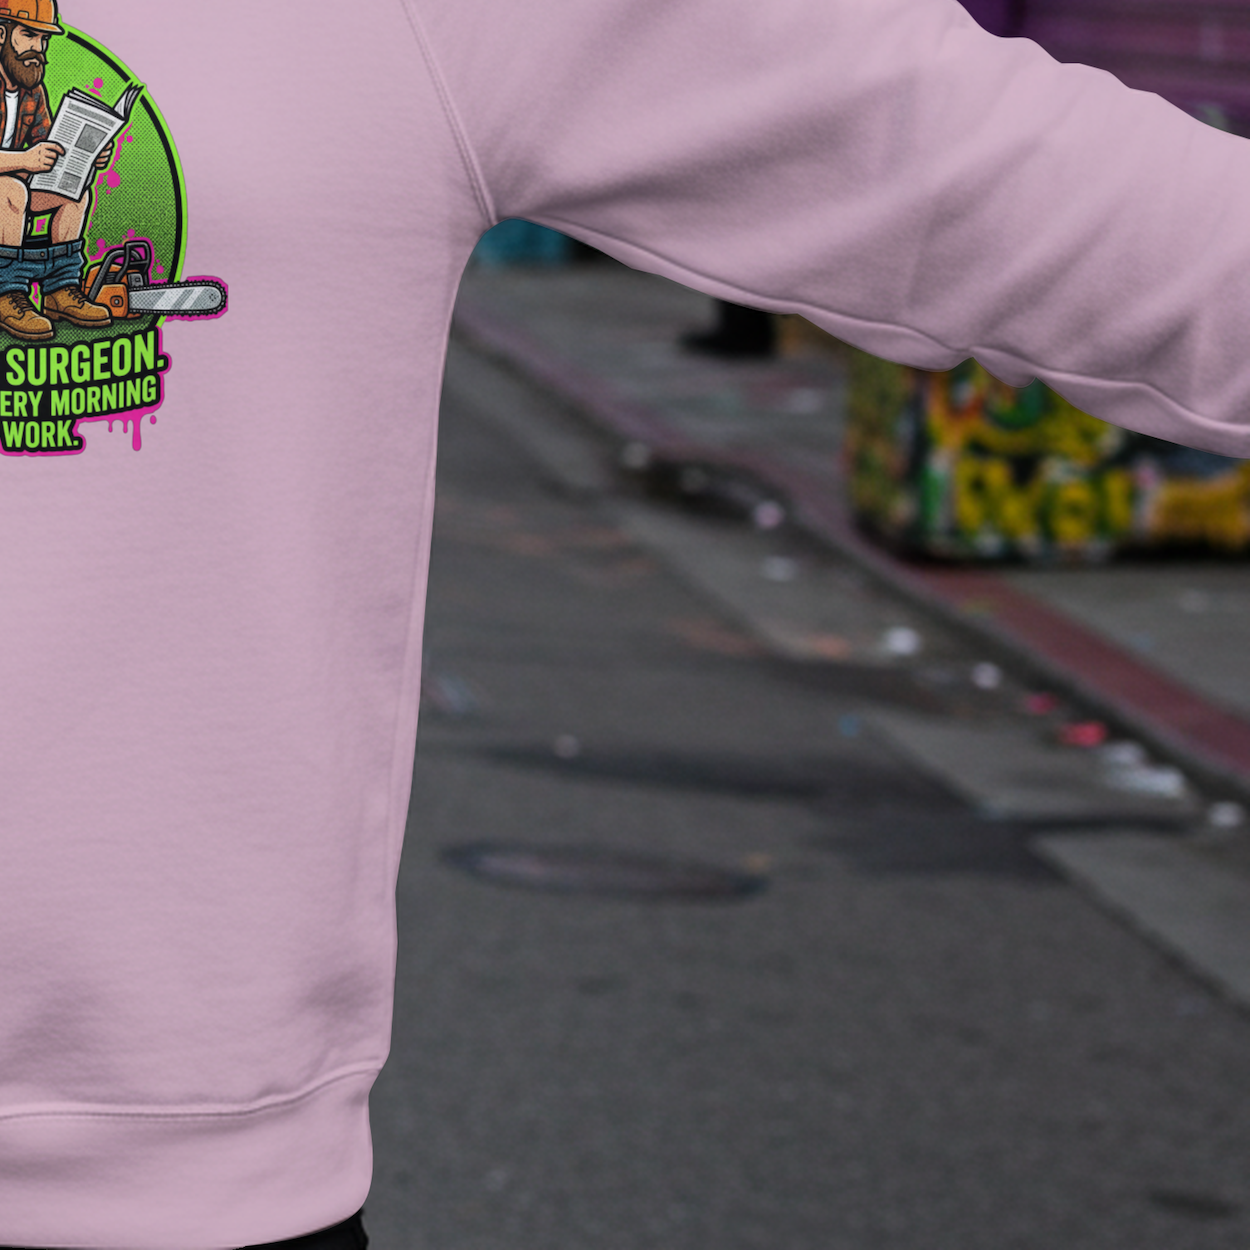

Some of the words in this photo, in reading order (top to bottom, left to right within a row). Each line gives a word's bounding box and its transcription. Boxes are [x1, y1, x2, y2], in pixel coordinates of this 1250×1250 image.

[6, 330, 165, 386] SURGEON.
[50, 375, 157, 417] MORNING
[2, 419, 80, 448] WORK.
